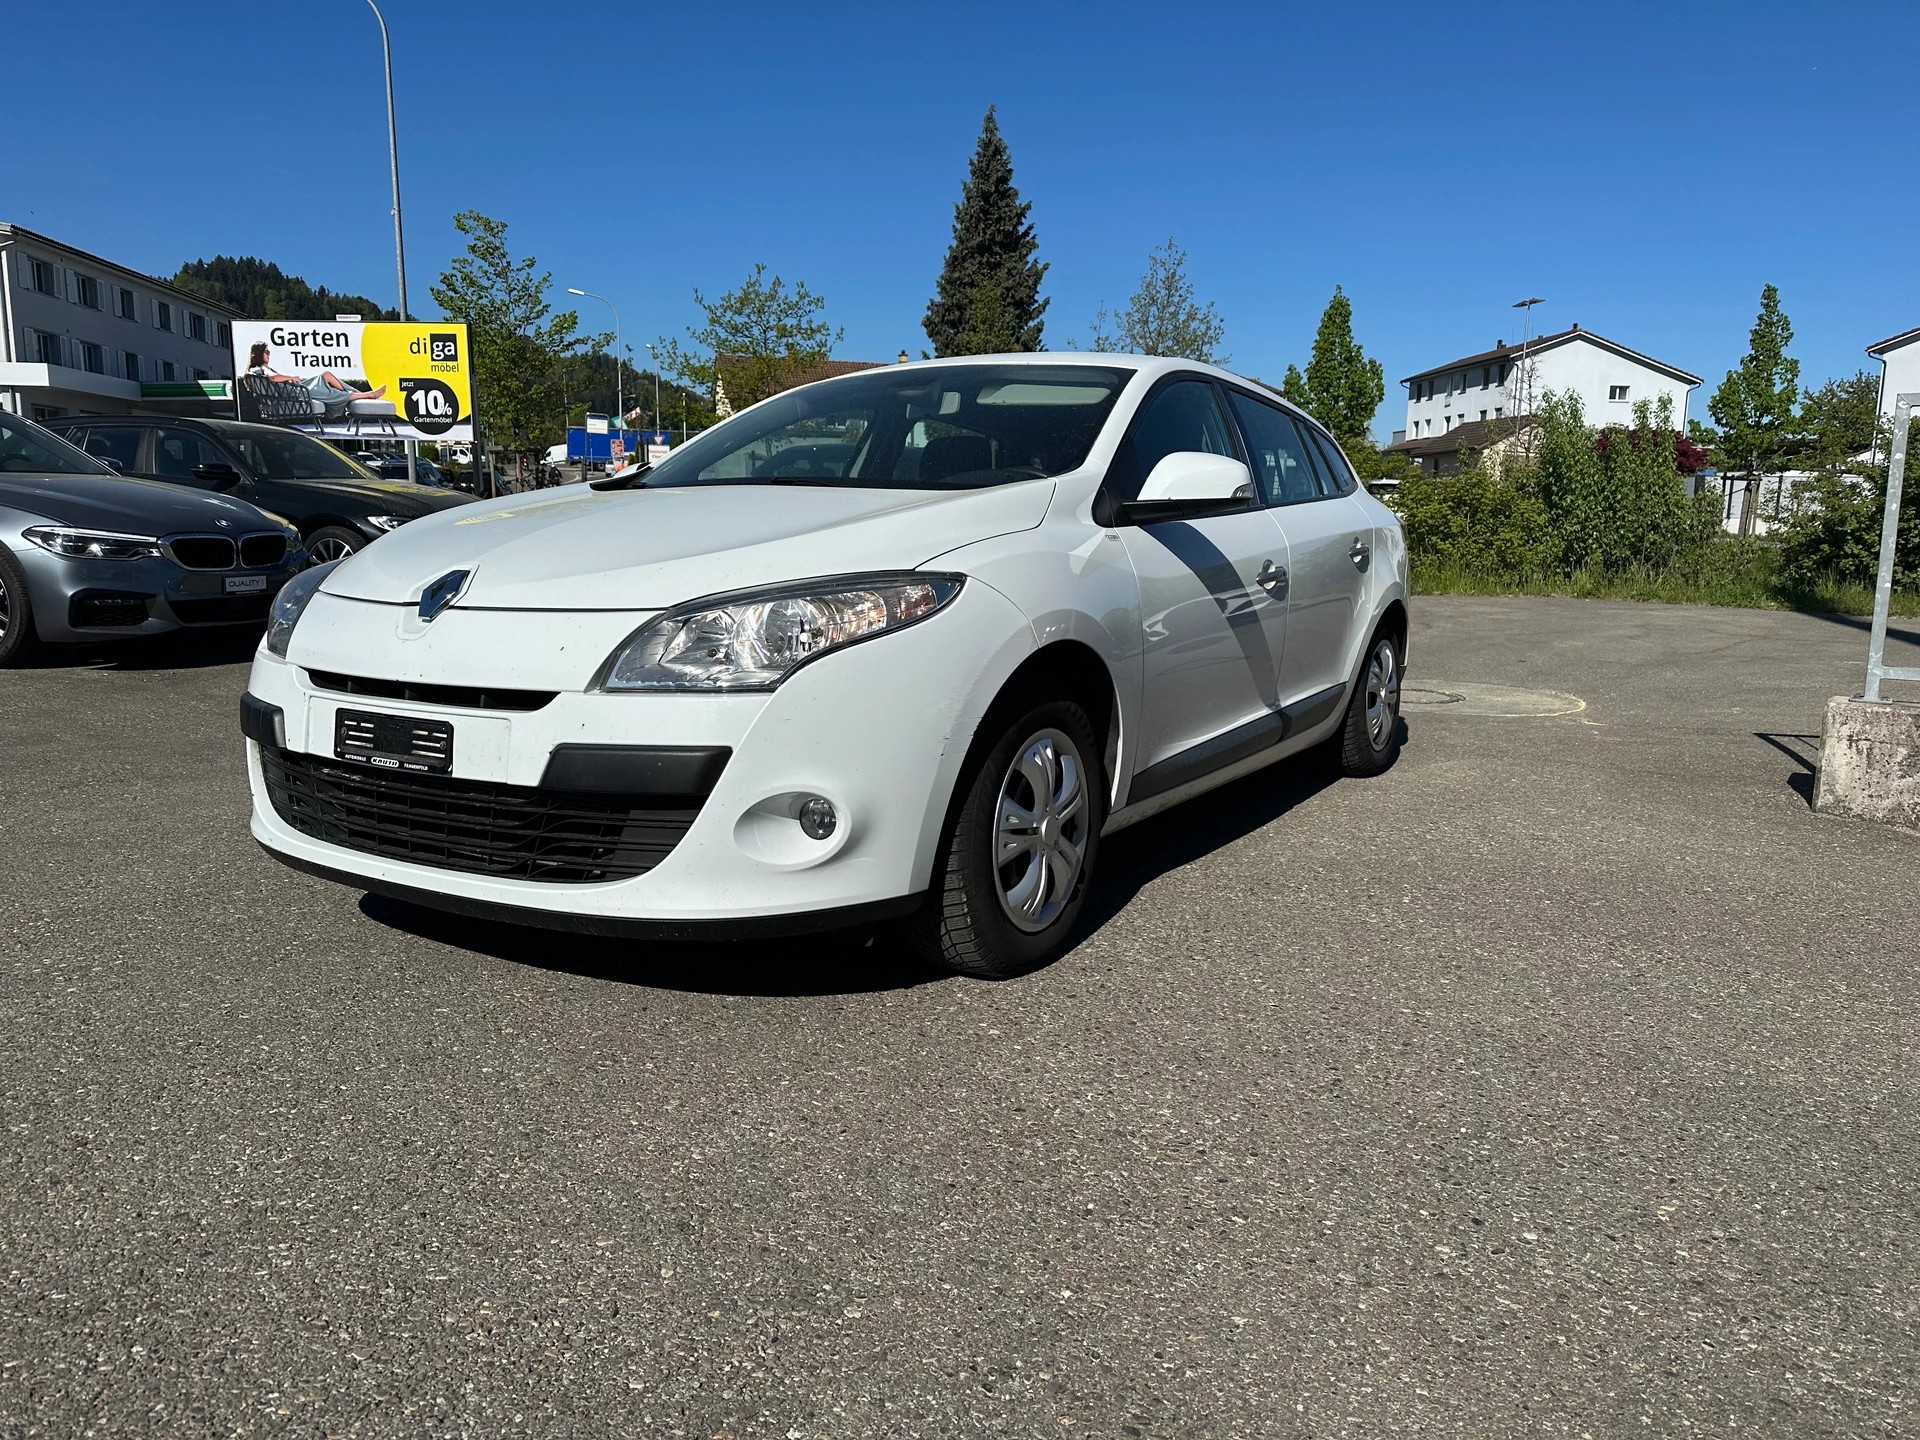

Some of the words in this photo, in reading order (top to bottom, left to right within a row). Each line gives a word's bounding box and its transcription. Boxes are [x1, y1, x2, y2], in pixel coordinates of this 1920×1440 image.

[270, 327, 349, 347] Garten
[410, 337, 455, 360] diga
[431, 363, 459, 372] möbel
[411, 389, 453, 416] 10%
